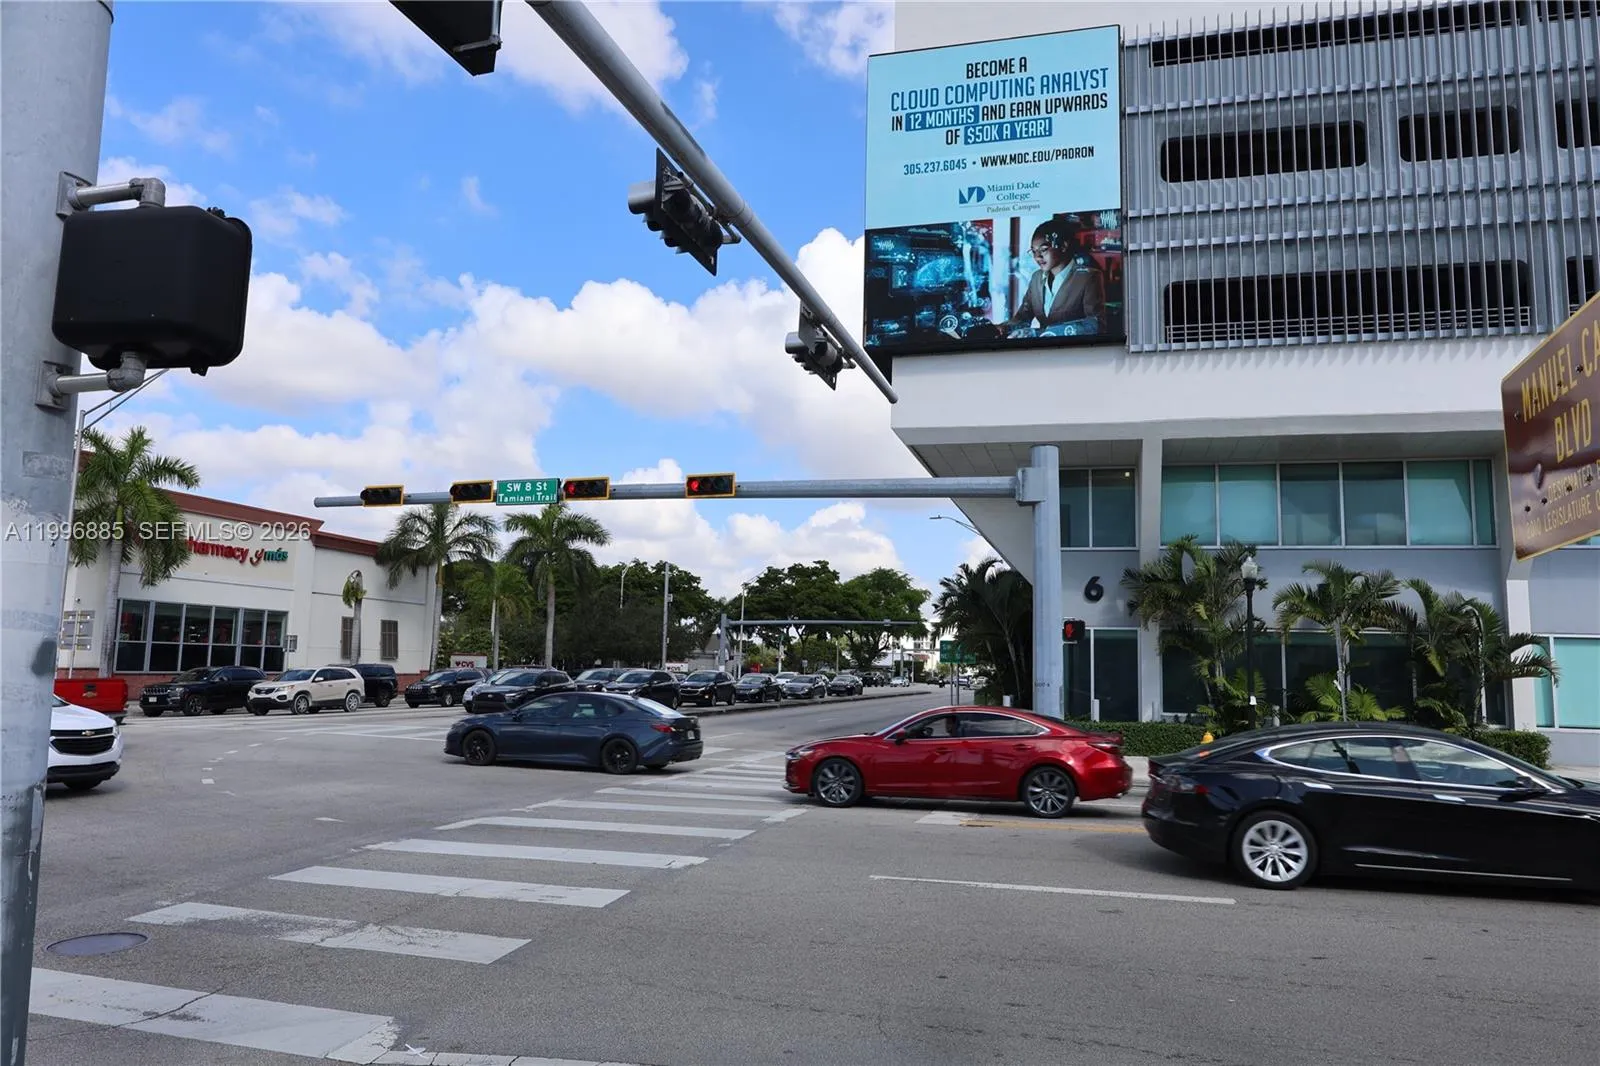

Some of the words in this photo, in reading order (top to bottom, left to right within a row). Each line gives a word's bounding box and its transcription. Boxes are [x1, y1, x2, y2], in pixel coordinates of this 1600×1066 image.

[966, 59, 1015, 79] BECOME
[1018, 56, 1028, 73] A
[891, 87, 939, 111] CLOUD
[944, 76, 1035, 105] COMPUTING
[1040, 67, 1109, 95] ANALYST
[891, 115, 903, 131] IN
[908, 114, 922, 130] 12
[925, 108, 975, 128] MONTHS
[981, 103, 1006, 121] AND
[1010, 99, 1041, 118] EARN
[1045, 92, 1108, 114] UPWARDS
[945, 128, 960, 145] OF
[967, 123, 1000, 144] $50K
[1002, 123, 1012, 139] A
[1014, 119, 1049, 138] YEAR!
[903, 158, 967, 176] 305.237.6045
[980, 145, 1095, 168] WWW.MDC.EDU/PADRON
[986, 183, 1015, 193] Miami
[1016, 180, 1040, 191] Dade
[996, 190, 1031, 202] College
[1521, 343, 1578, 423] MANUEL
[1553, 398, 1592, 464] BLVD
[498, 493, 535, 503] Tamiami
[536, 492, 556, 501] Trail
[506, 482, 521, 492] SW
[524, 482, 532, 492] 8
[536, 481, 547, 491] St
[1544, 494, 1593, 533] LEGISLATURE
[249, 548, 264, 566] y
[1084, 576, 1104, 602] 6
